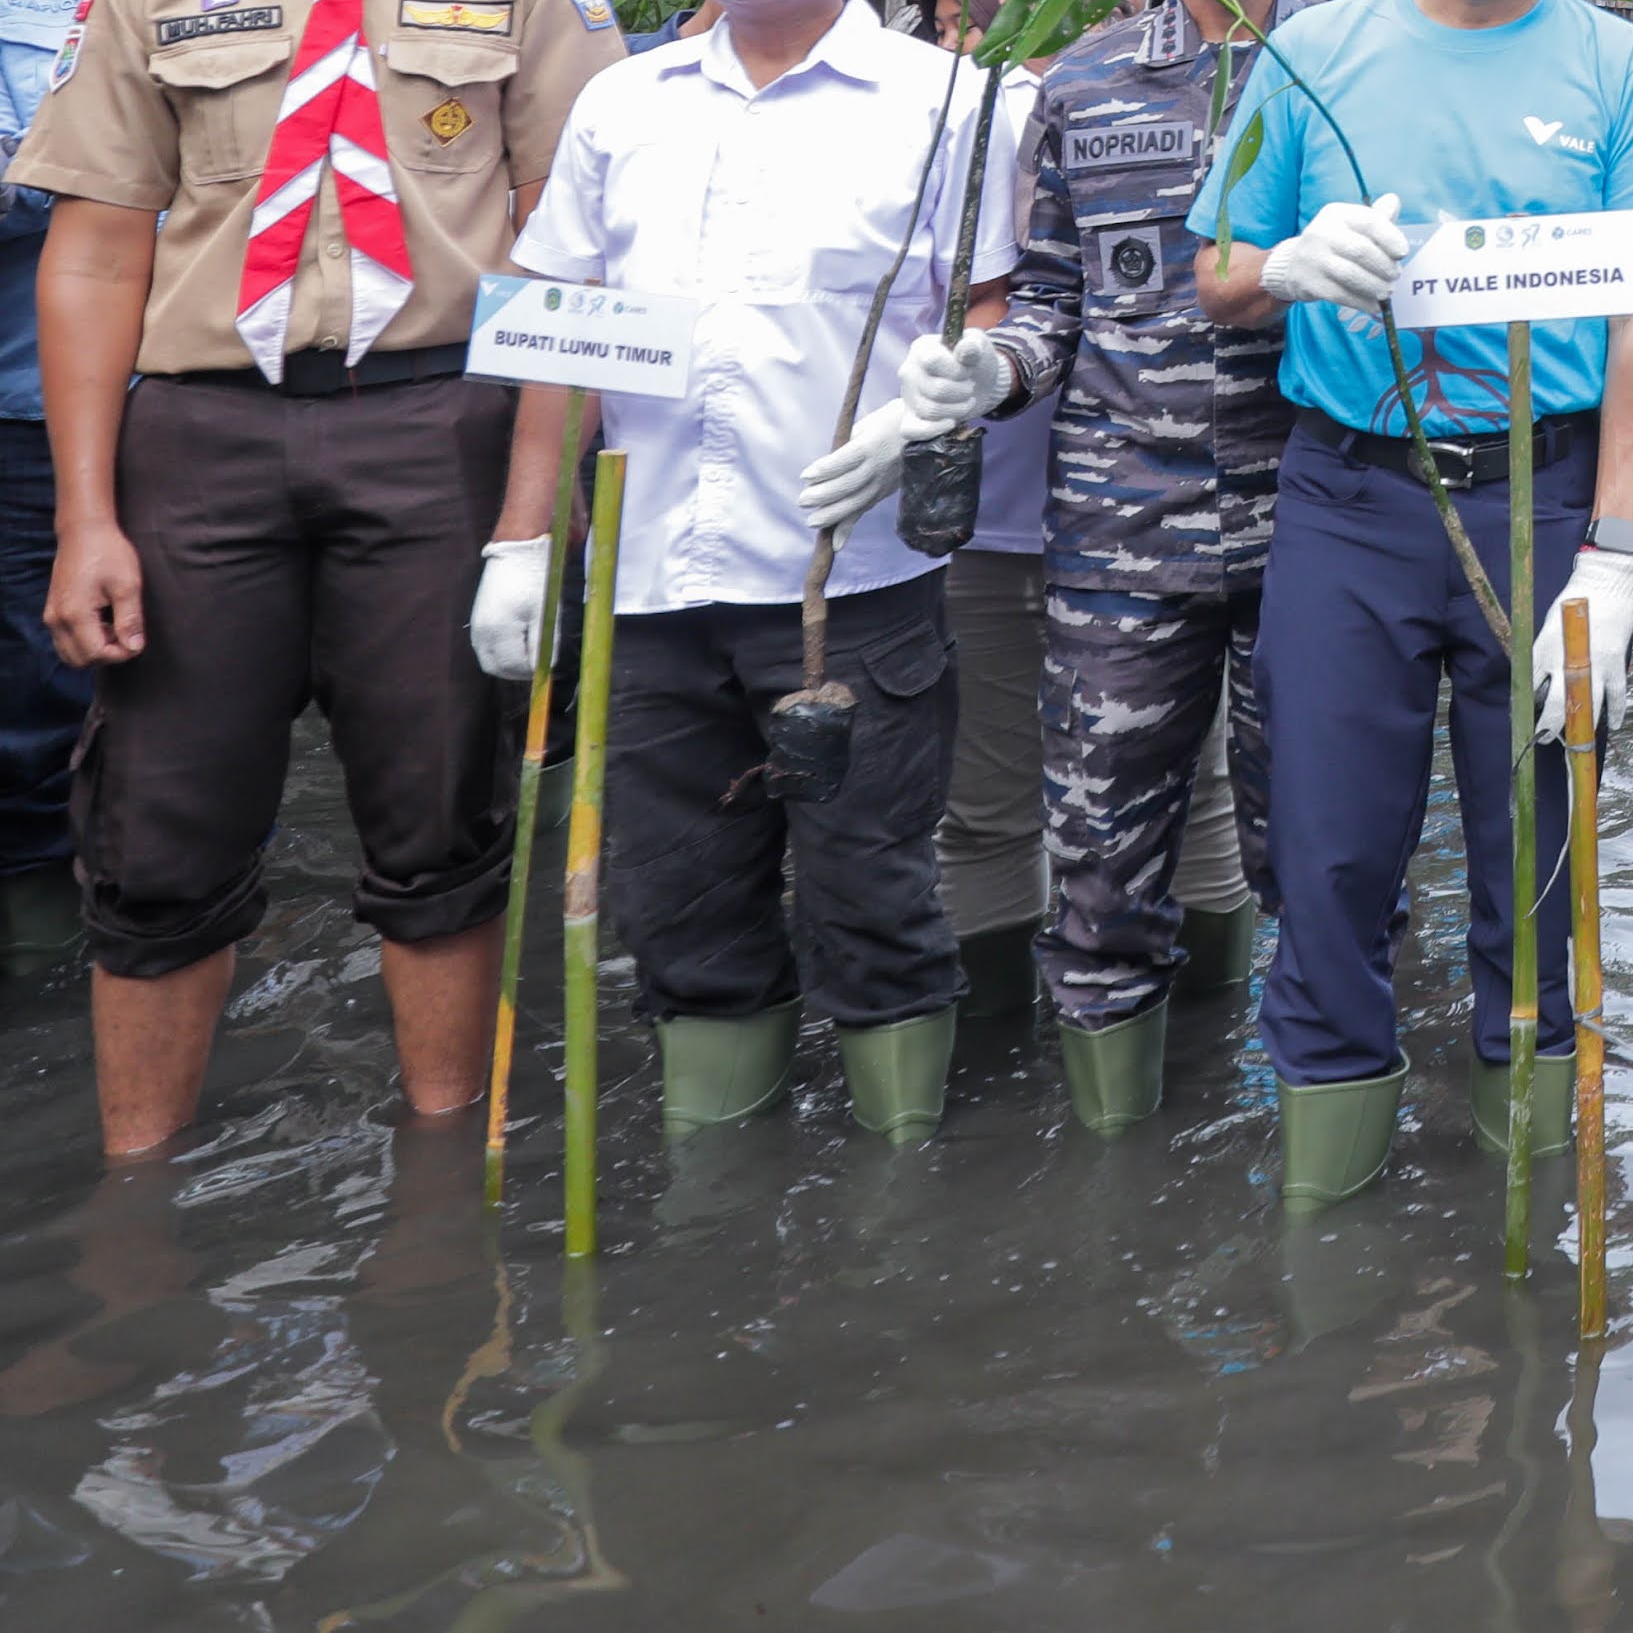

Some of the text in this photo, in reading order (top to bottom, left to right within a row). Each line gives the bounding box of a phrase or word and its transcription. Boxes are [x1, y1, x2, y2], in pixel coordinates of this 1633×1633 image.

[1074, 129, 1183, 160] NOPRIADI
[1559, 134, 1596, 153] VALE
[1412, 267, 1624, 296] PT VALE INDONESIA
[494, 330, 673, 366] BUPATI LUWU TIMUR
